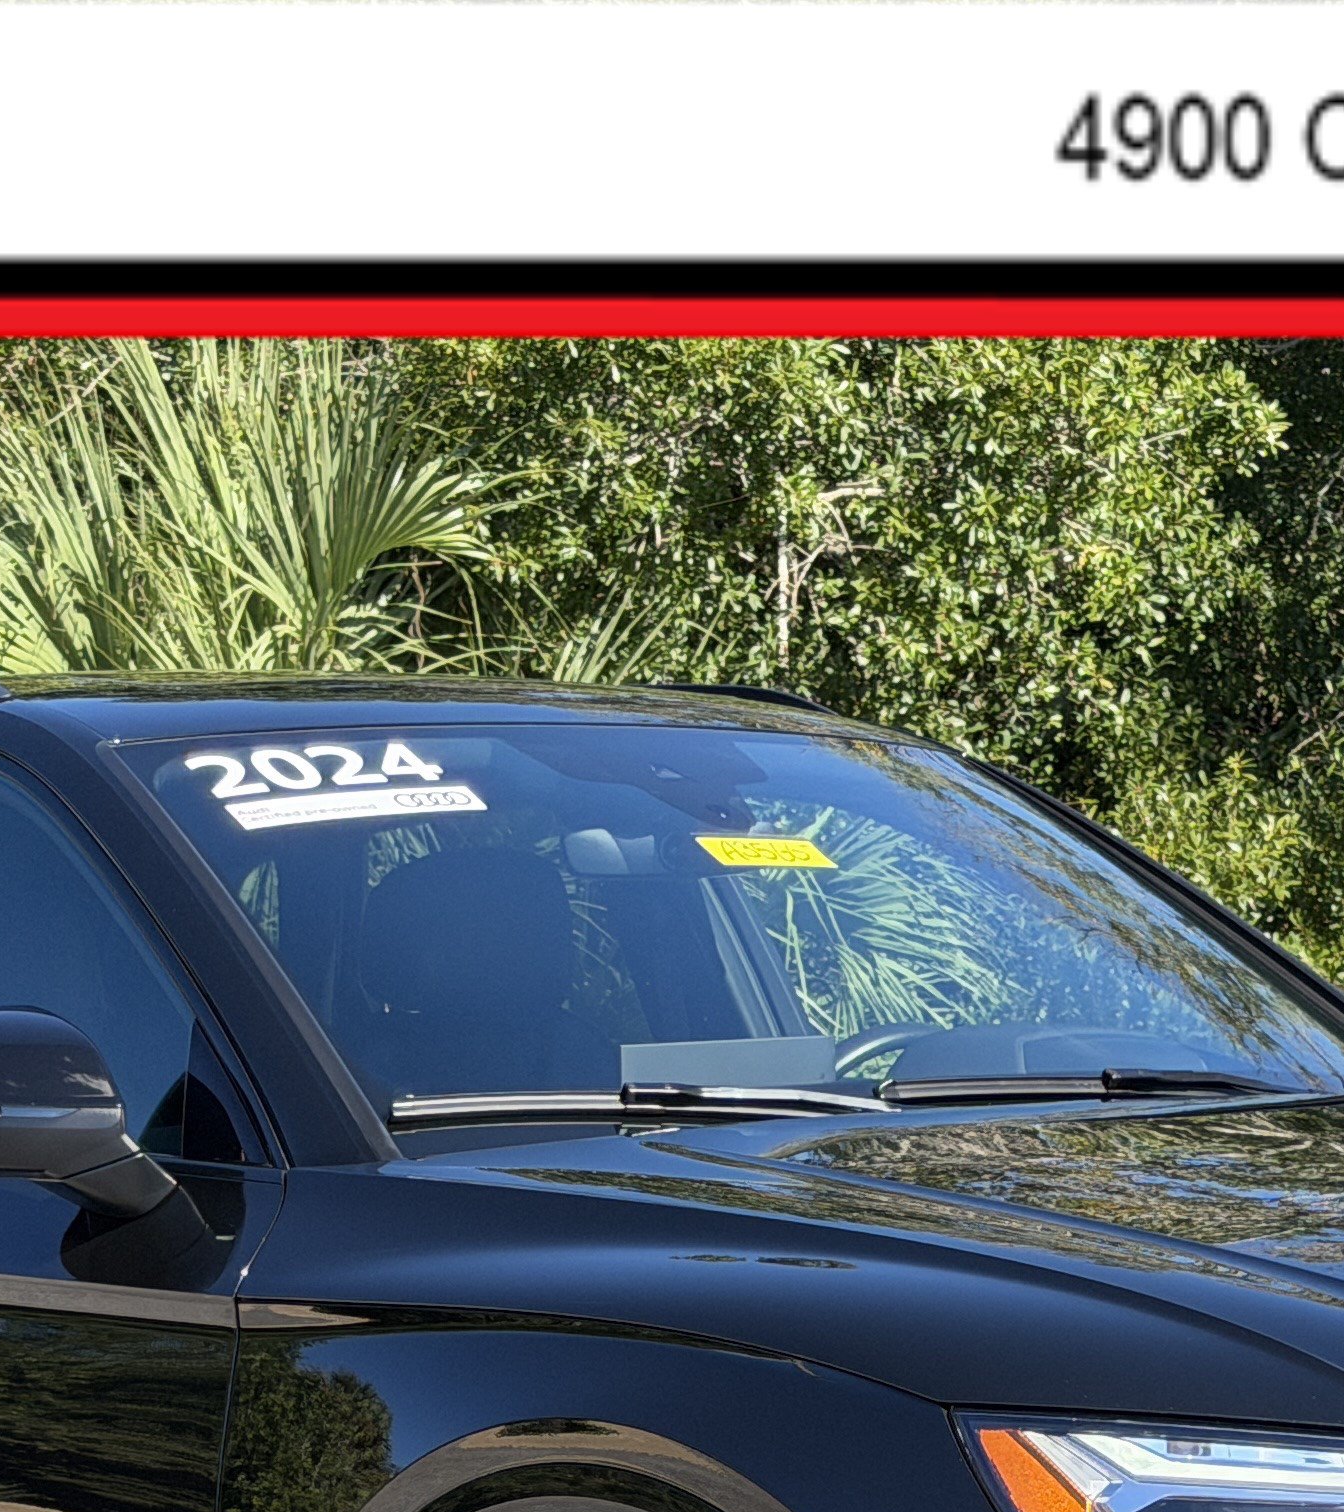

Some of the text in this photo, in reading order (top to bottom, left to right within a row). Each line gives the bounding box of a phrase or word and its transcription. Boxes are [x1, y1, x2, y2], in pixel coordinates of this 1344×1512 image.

[184, 742, 444, 799] 2024
[237, 807, 271, 816] Audi
[242, 803, 377, 822] Certified pre-owned
